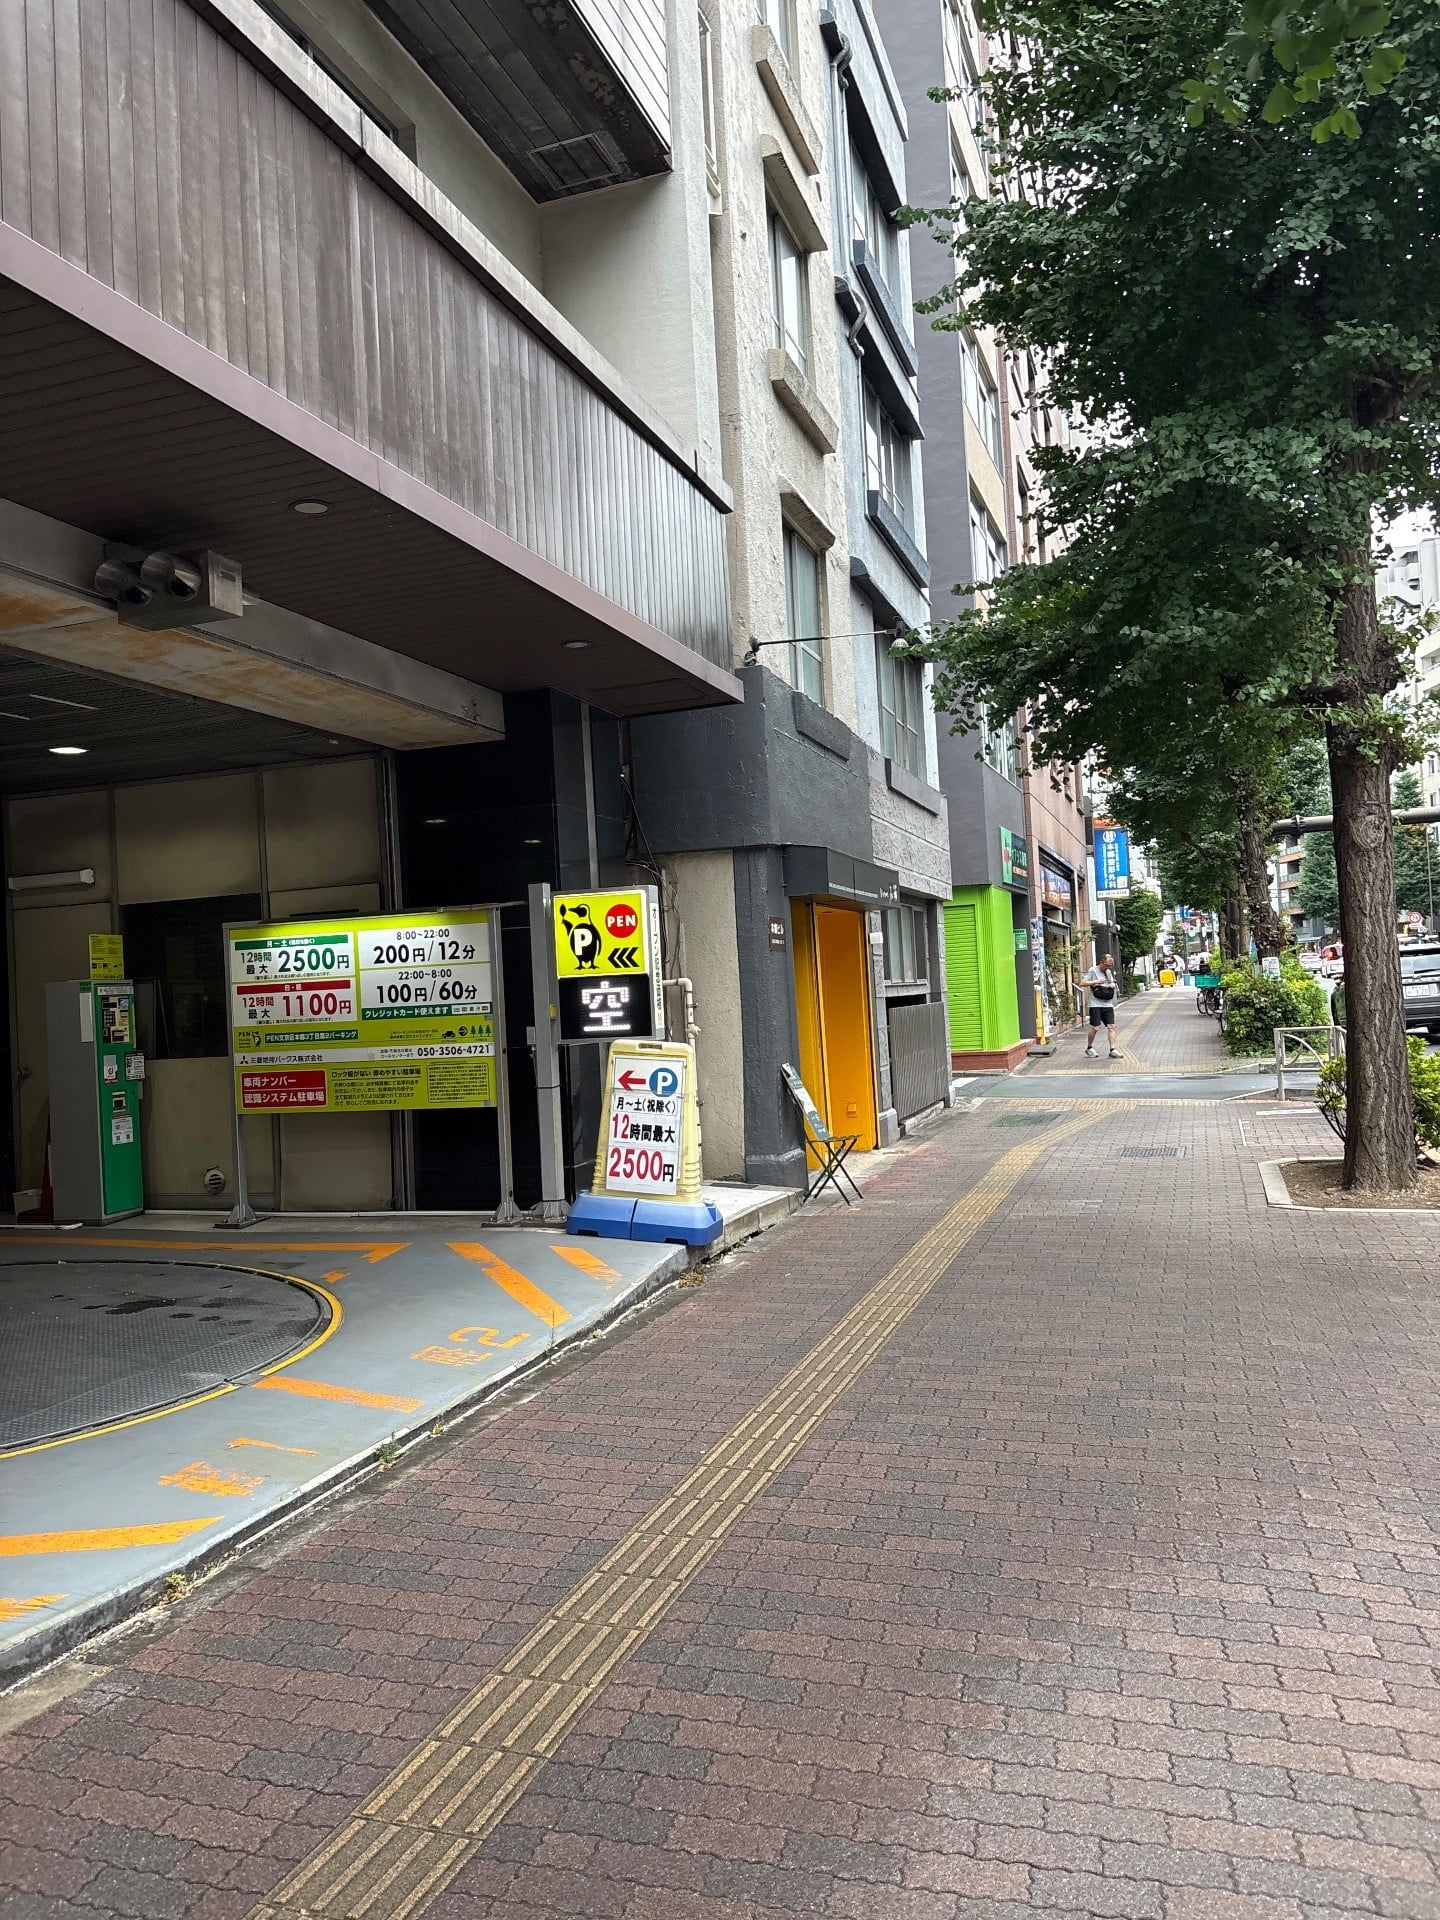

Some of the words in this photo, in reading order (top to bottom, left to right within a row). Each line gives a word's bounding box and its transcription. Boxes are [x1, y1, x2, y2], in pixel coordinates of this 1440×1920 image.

[606, 915, 637, 928] PEN
[396, 928, 450, 941] 8:00～22:00
[573, 928, 593, 956] P
[240, 951, 272, 963] 12時間
[278, 947, 350, 973] 2500円
[246, 964, 268, 975] 最大
[398, 969, 452, 981] 22:00～8:00
[242, 996, 274, 1008] 12時間
[282, 992, 352, 1017] 1100円
[581, 980, 631, 1032] 空
[248, 1008, 270, 1020] 最大
[364, 1007, 449, 1019] クレジットカード使えます
[417, 1044, 490, 1057] 050-3506-4721
[243, 1075, 297, 1088] 車両ナンバー
[656, 1072, 673, 1095] P
[244, 1091, 325, 1104] 認識システム駐車場
[612, 1113, 676, 1144] 12時間最大
[608, 1147, 675, 1183] 2500円
